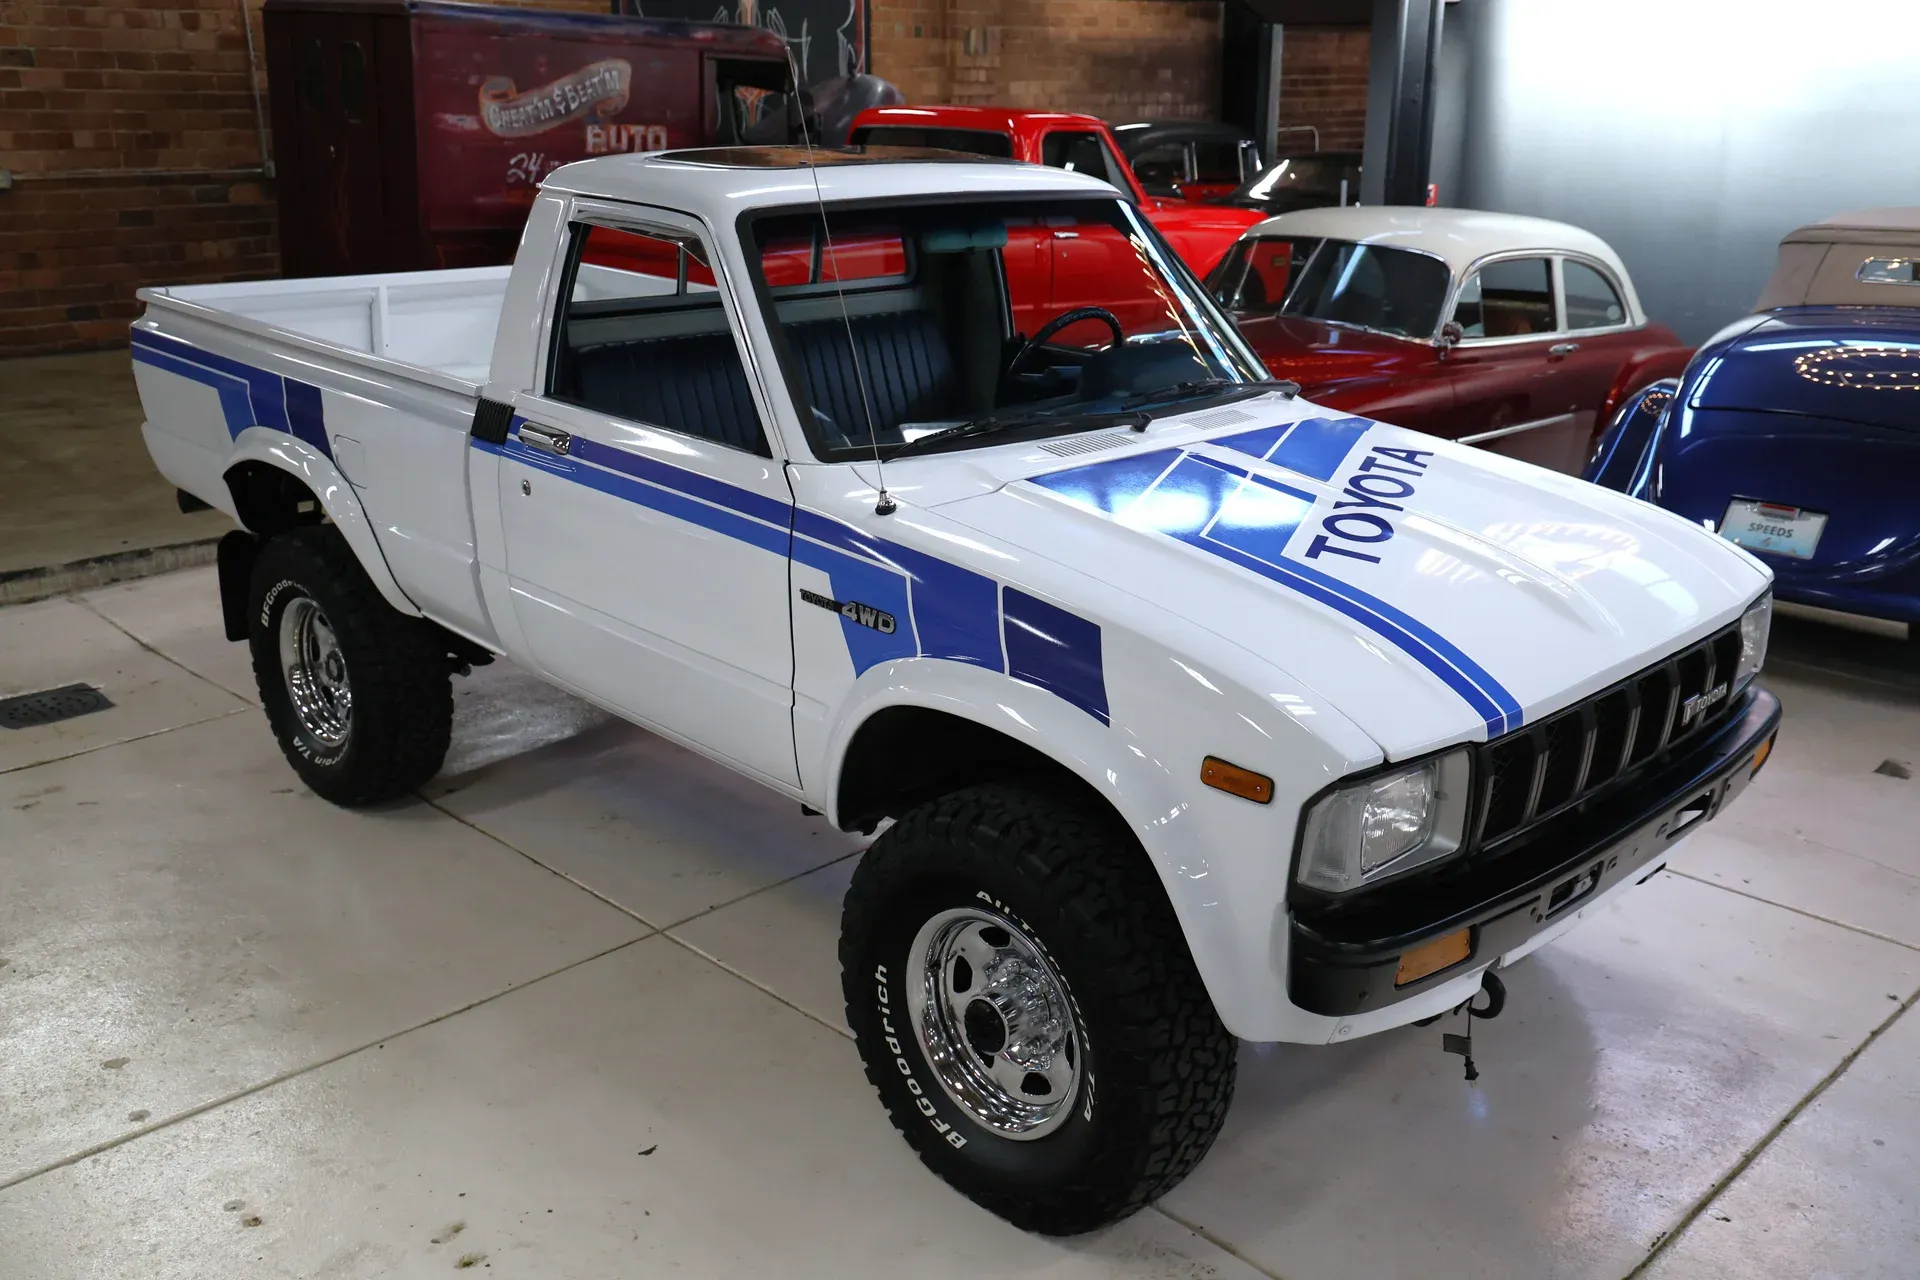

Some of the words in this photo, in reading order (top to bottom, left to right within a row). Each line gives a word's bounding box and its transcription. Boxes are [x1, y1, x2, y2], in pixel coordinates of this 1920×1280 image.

[586, 124, 668, 153] AUTO
[505, 152, 545, 184] 24
[1304, 446, 1435, 565] TOYOTA
[1747, 522, 1795, 538] SPEEDS
[799, 588, 835, 612] TOYOTA
[841, 601, 896, 634] 4WD
[1696, 681, 1728, 712] TOYOTA
[292, 735, 312, 760] T/A
[875, 964, 968, 1149] BFGoodrich
[1083, 1071, 1096, 1122] T/A
